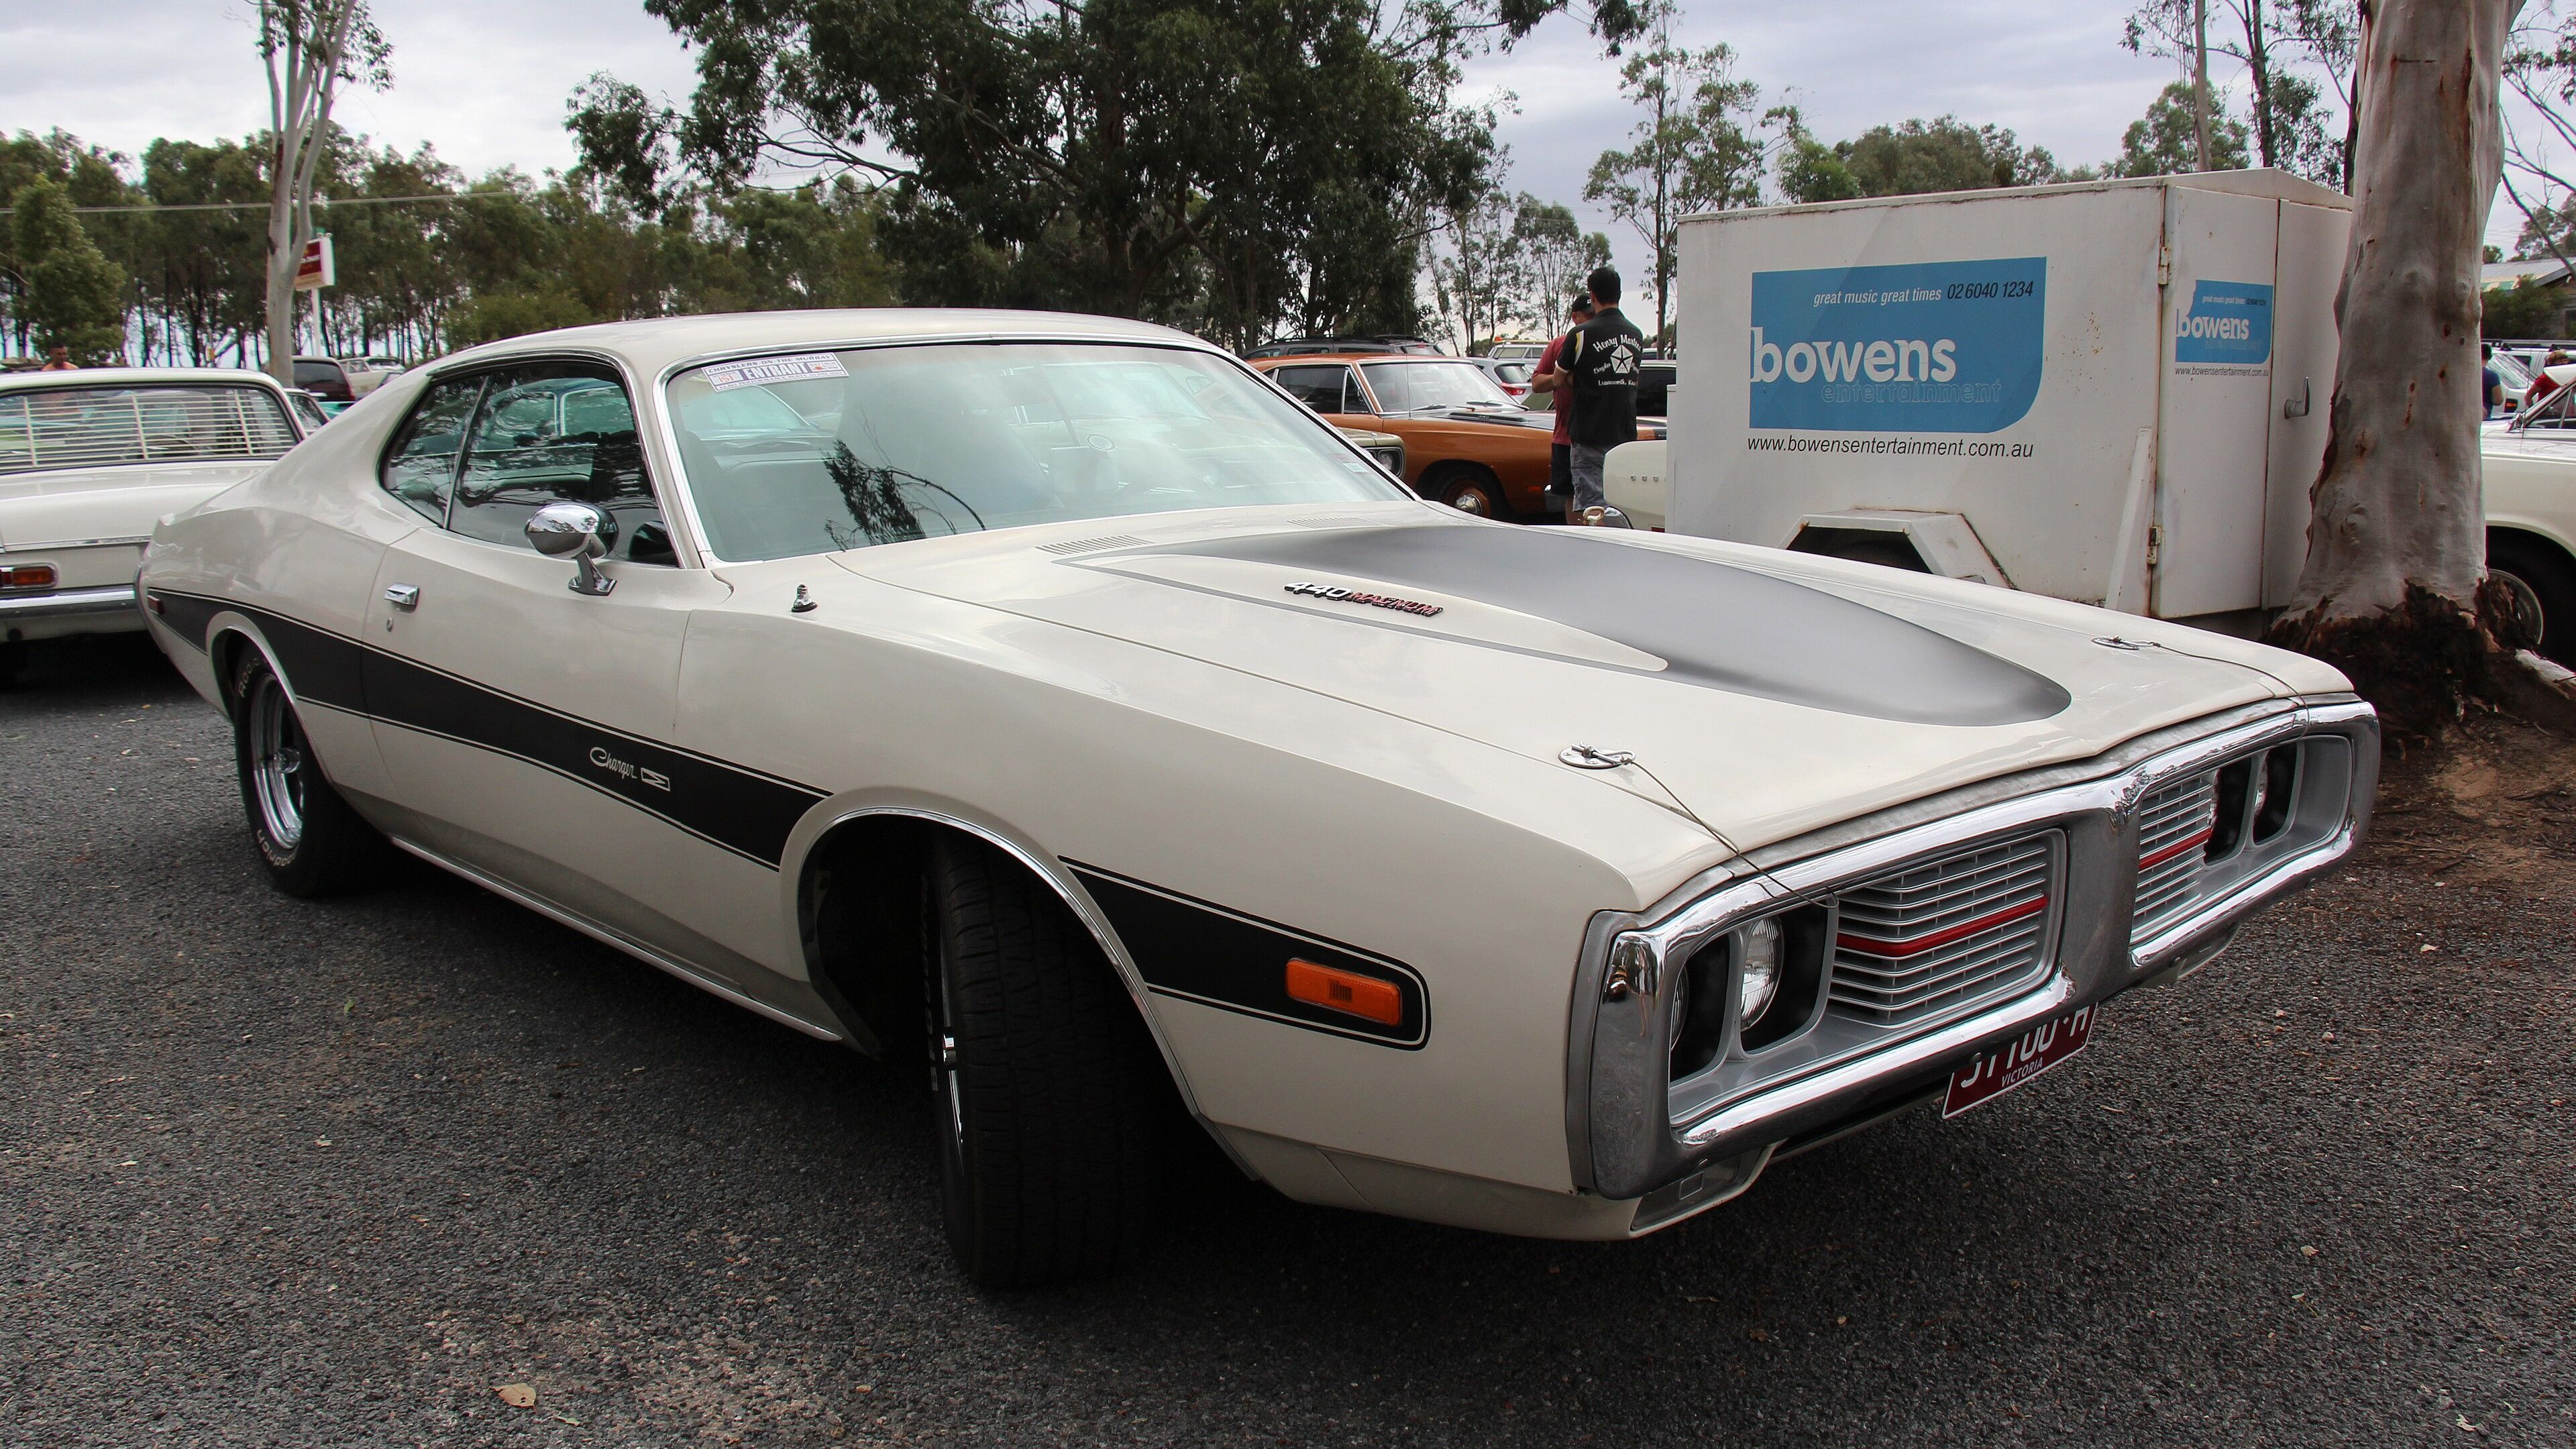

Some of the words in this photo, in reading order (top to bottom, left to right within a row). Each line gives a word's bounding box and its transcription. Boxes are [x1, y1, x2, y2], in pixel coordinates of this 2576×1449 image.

[1813, 290, 1842, 307] great
[1844, 289, 1878, 304] music
[1880, 288, 1910, 306] great
[1912, 287, 1942, 302] times
[2002, 280, 2035, 298] 1234
[2176, 308, 2249, 340] bowens
[1593, 337, 1618, 352] Henry
[1750, 325, 1957, 383] bowens
[708, 362, 758, 374] CHRYSLERS
[795, 354, 831, 362] MURRAY
[745, 362, 808, 380] ENTRANT
[2175, 366, 2269, 378] www.bowensentertainment.com.au
[1821, 378, 2002, 402] entertainment
[1748, 435, 2034, 458] www.bowensentertainment.com.au
[1283, 581, 1352, 601] 440
[1344, 591, 1444, 618] MAGNUM
[590, 747, 637, 780] Charger
[2002, 1057, 2043, 1087] VICTORIA
